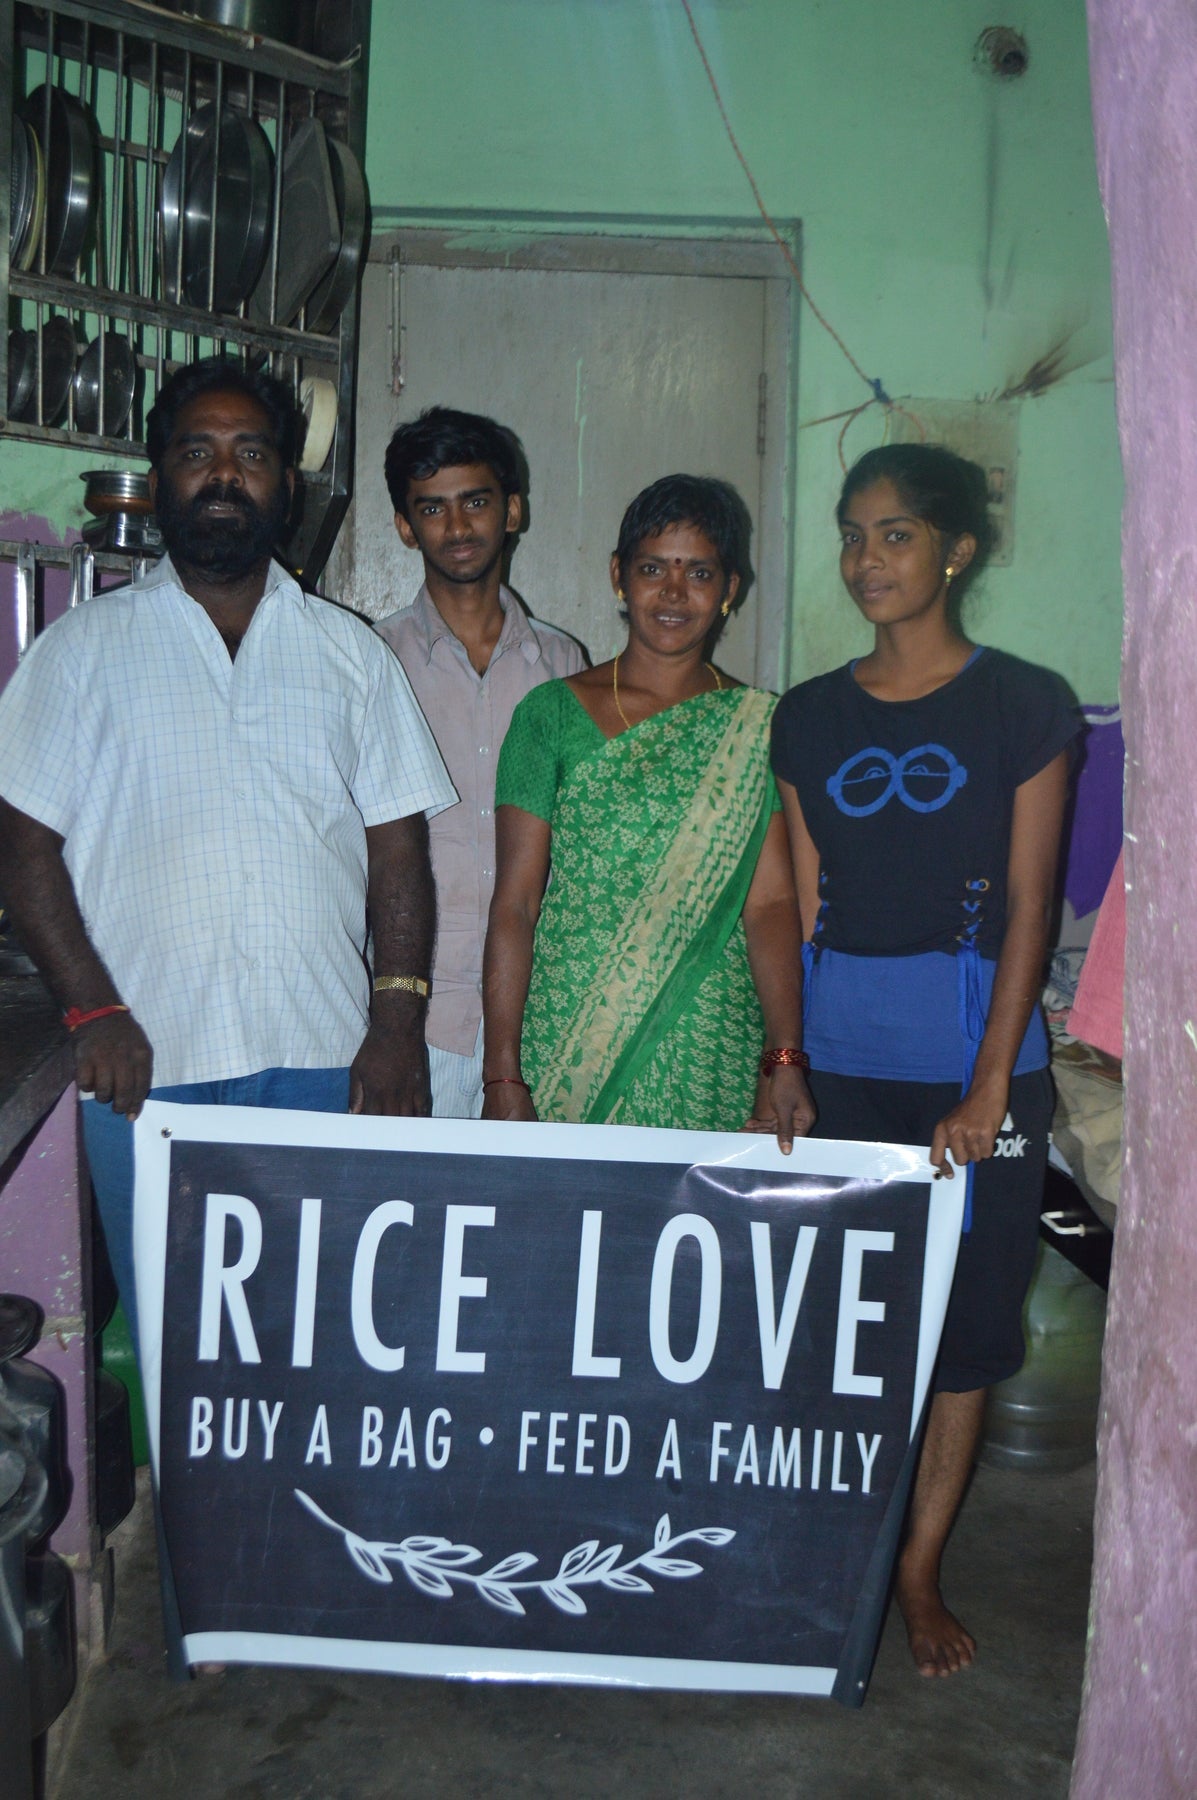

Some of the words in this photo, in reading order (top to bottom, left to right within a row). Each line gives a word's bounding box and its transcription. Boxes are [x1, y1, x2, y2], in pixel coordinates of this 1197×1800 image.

[198, 1192, 497, 1374] RICE
[571, 1209, 895, 1397] LOVE
[189, 1396, 284, 1460] BUY
[305, 1404, 332, 1466] A
[359, 1405, 452, 1470] BAG
[518, 1410, 631, 1476] FEED
[655, 1418, 682, 1480] A
[709, 1421, 882, 1494] FAMILY
